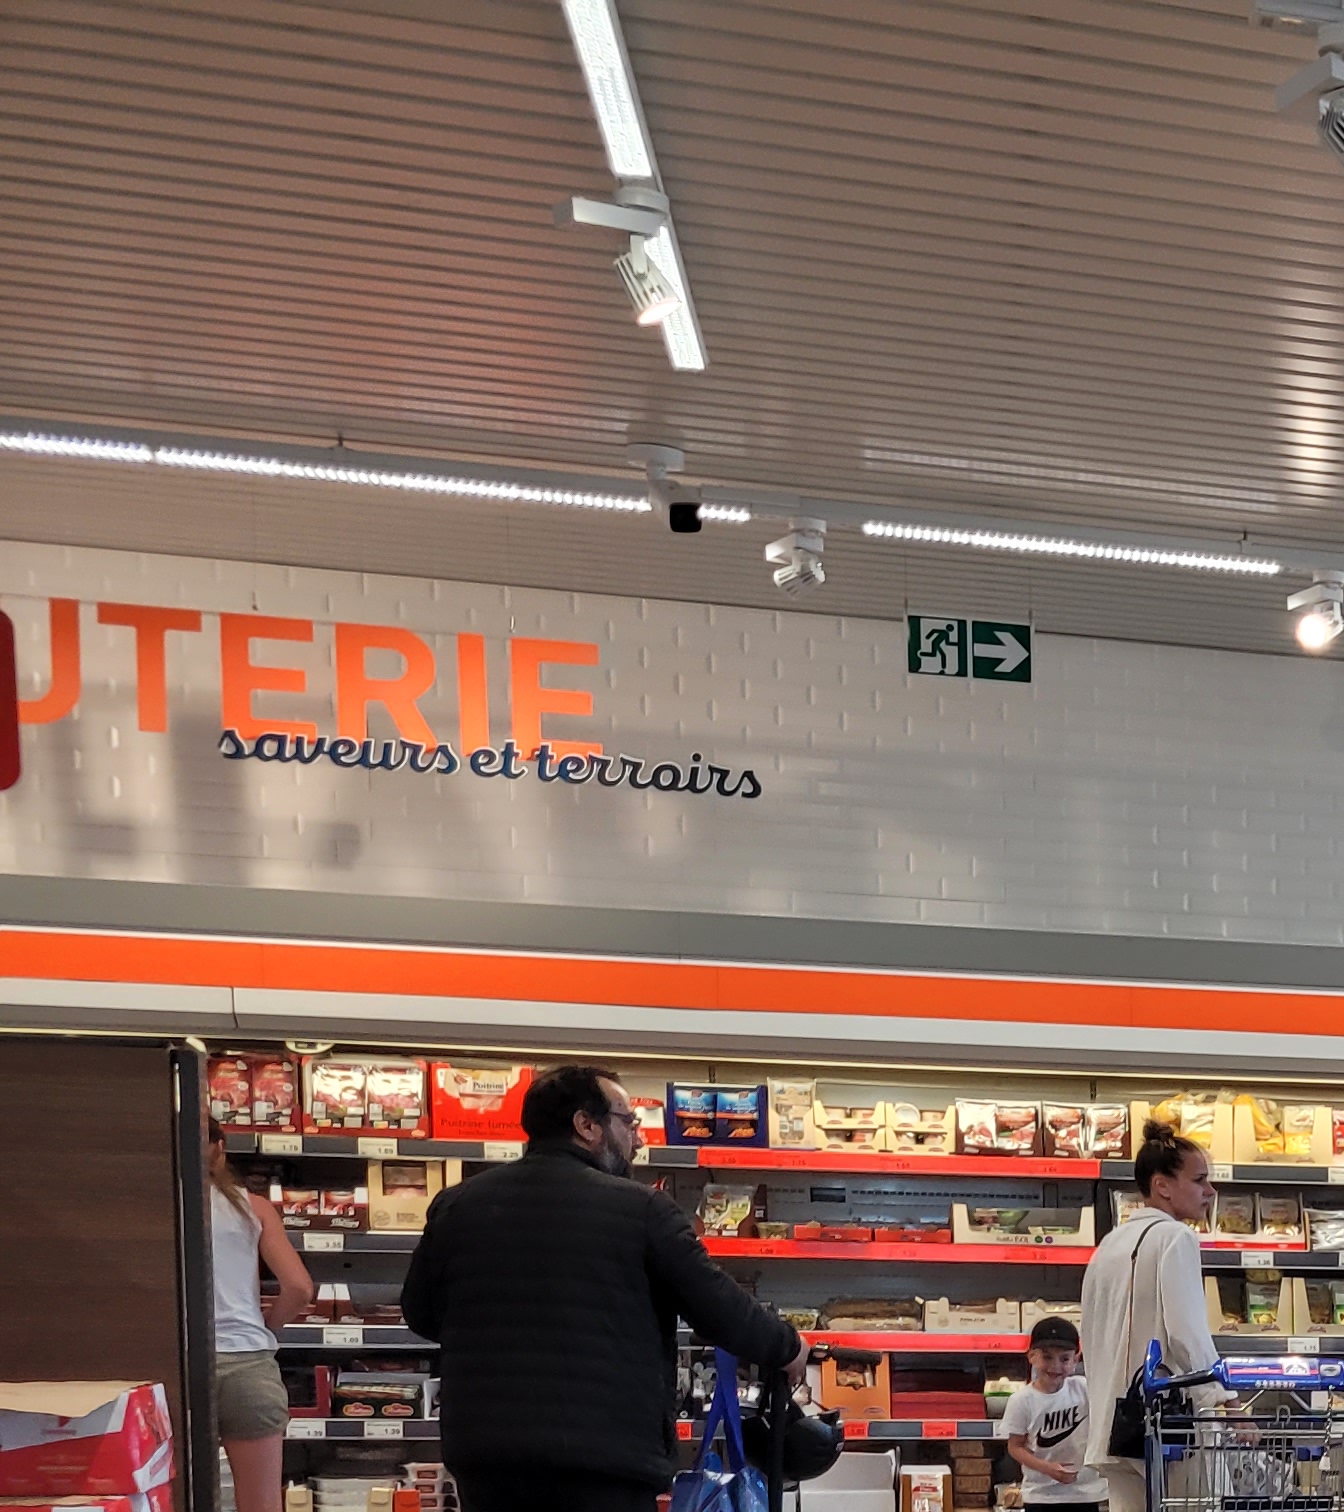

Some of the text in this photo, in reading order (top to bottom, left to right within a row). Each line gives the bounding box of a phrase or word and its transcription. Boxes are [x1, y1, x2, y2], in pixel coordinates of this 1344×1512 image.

[218, 727, 763, 799] saveurs et terroirs
[1043, 1405, 1080, 1433] NIKE
